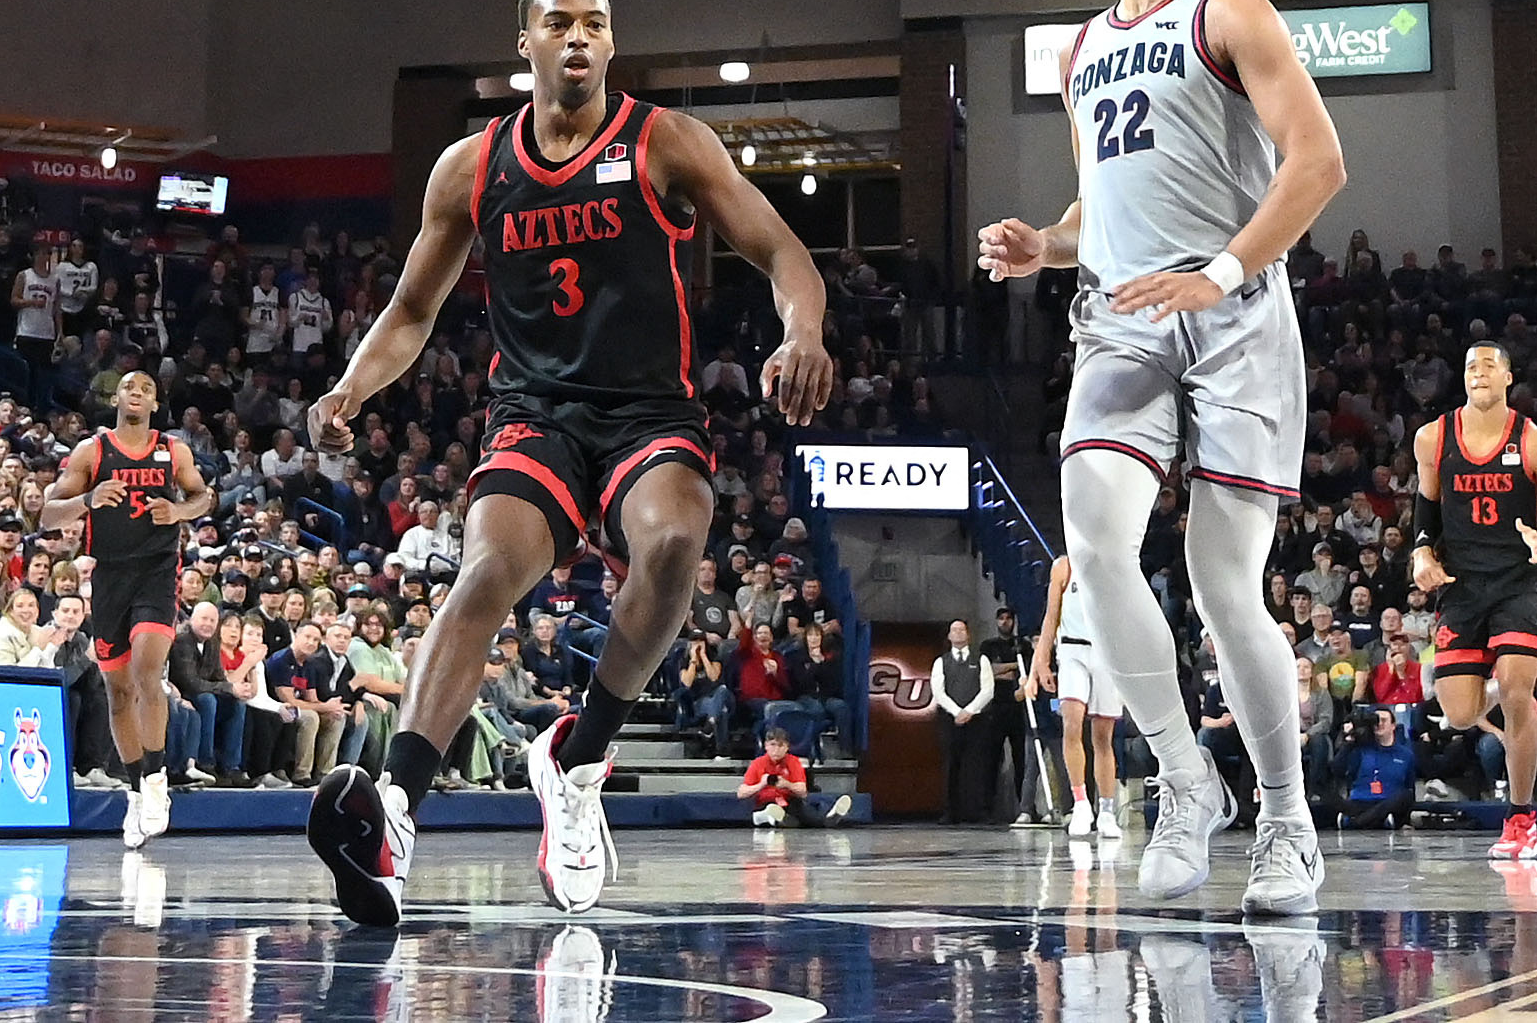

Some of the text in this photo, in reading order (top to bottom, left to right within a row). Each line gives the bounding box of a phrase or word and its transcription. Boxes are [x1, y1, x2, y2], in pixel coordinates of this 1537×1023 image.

[1292, 21, 1391, 72] gWest
[1315, 55, 1385, 68] FARM CREDIT
[1072, 41, 1186, 108] GONZAGA
[1094, 89, 1155, 163] 22
[31, 161, 136, 182] TACO SALAD
[502, 197, 623, 252] AZTECS
[548, 257, 585, 317] 3
[111, 468, 165, 486] AZTECS
[836, 462, 947, 486] READY
[1453, 473, 1513, 493] AZTECS
[130, 491, 146, 519] 5
[1470, 496, 1499, 526] 13
[869, 663, 933, 710] GU
